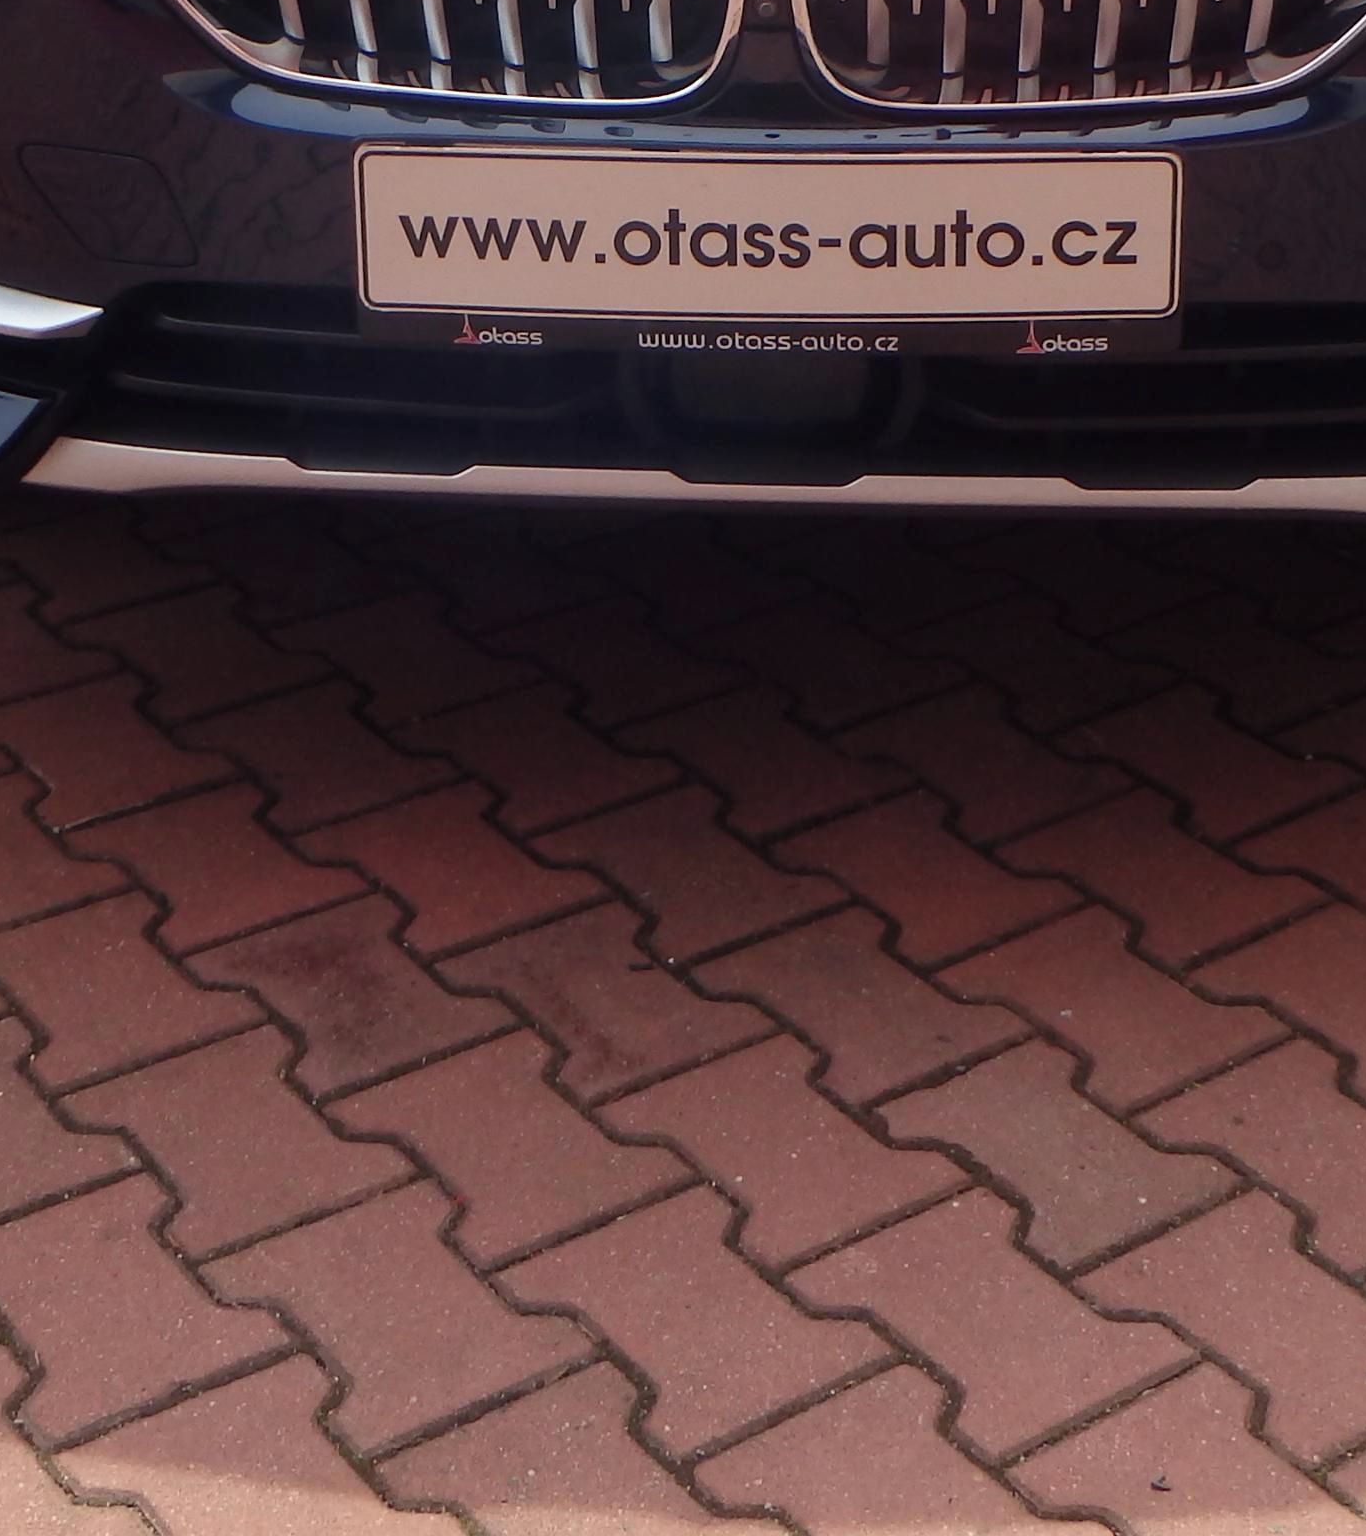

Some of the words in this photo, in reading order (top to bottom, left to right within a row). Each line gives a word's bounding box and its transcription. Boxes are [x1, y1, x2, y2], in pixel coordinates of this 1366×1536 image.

[398, 209, 1139, 268] www.otass-auto.cz
[478, 327, 543, 345] otass
[638, 332, 900, 352] www.otass-auto.cz
[1042, 334, 1109, 352] otass
